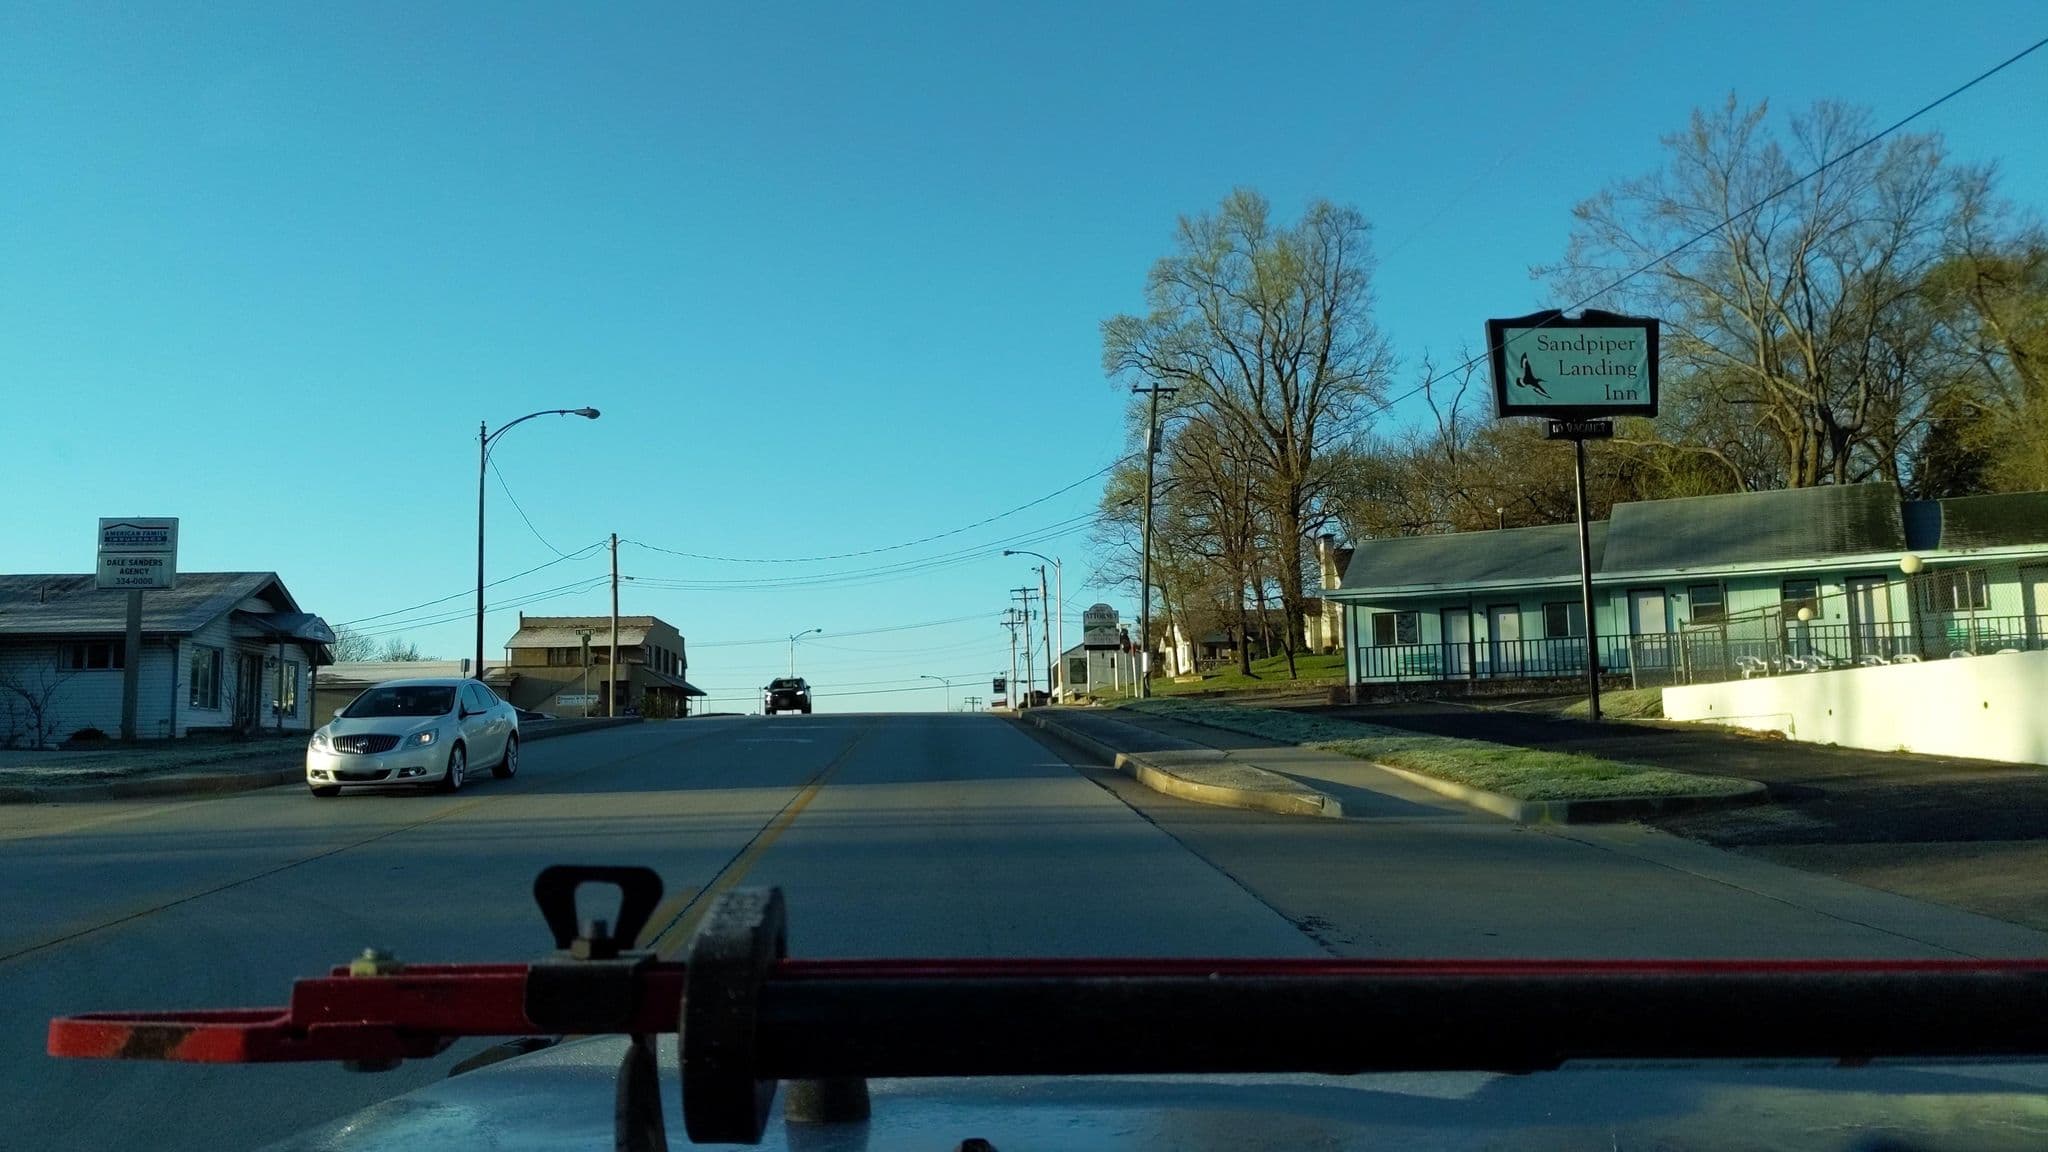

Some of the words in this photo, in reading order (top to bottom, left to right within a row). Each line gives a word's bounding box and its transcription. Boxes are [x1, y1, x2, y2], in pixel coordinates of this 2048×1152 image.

[1537, 334, 1636, 355] Sandpiper
[1559, 359, 1638, 379] Landing
[1605, 384, 1638, 401] Inn
[106, 559, 125, 567] DALE
[128, 559, 163, 567] SANDERS
[119, 567, 150, 575] AGENCY
[115, 577, 153, 585] 334-0000
